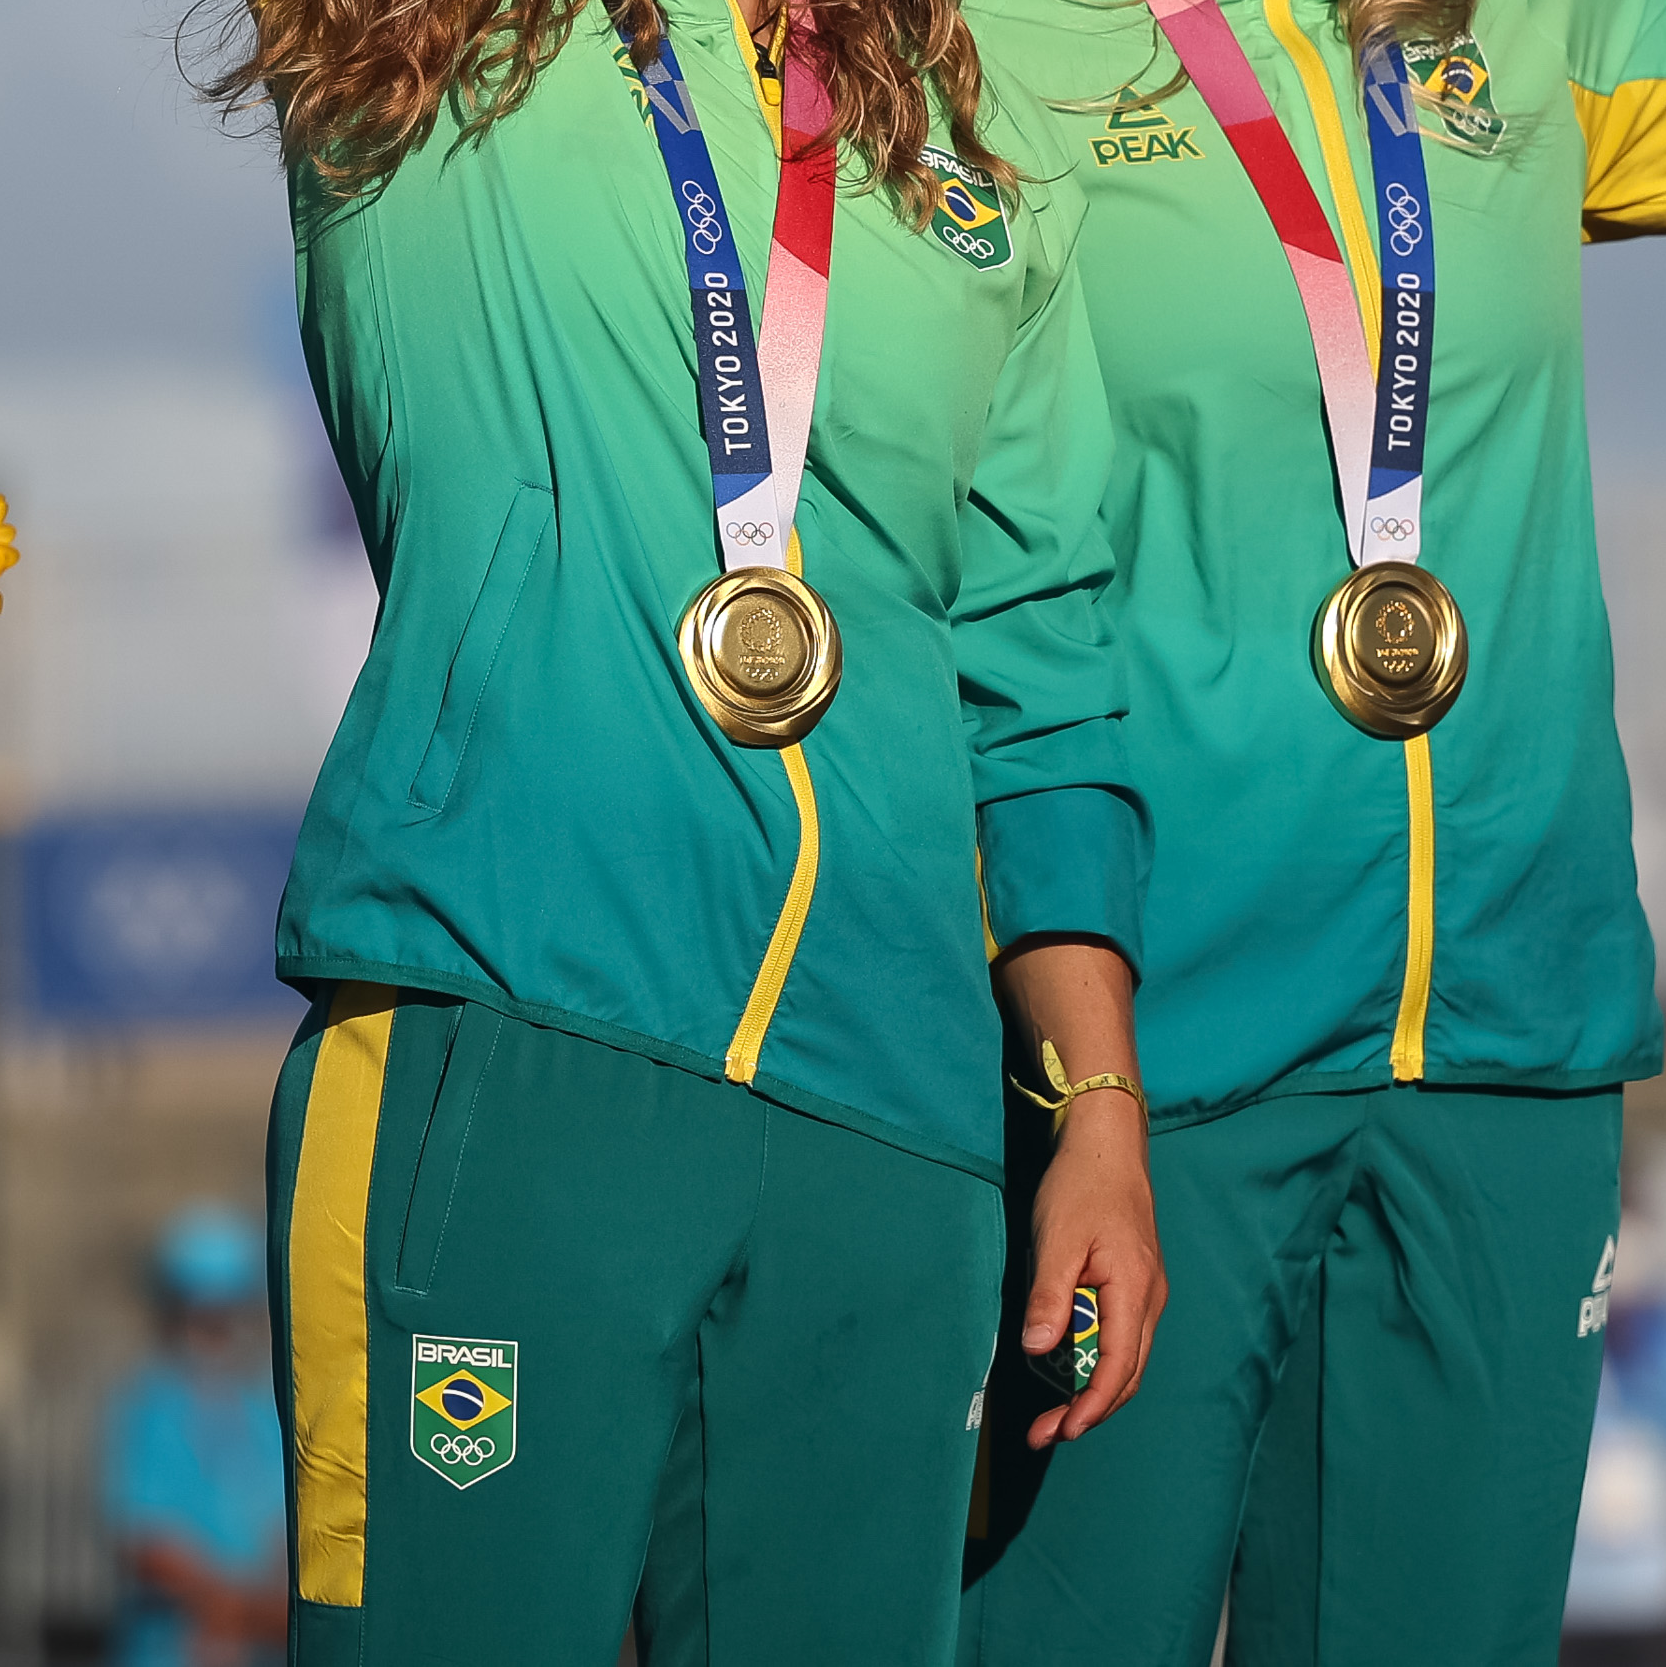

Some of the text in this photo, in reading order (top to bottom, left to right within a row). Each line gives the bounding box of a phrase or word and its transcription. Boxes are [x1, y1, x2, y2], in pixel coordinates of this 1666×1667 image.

[1088, 126, 1206, 168] PEAK
[916, 150, 994, 188] BRASIL
[704, 272, 752, 456] TOKYO 2020
[1387, 272, 1422, 452] TOKYO 2020
[417, 1341, 513, 1369] BRASIL
